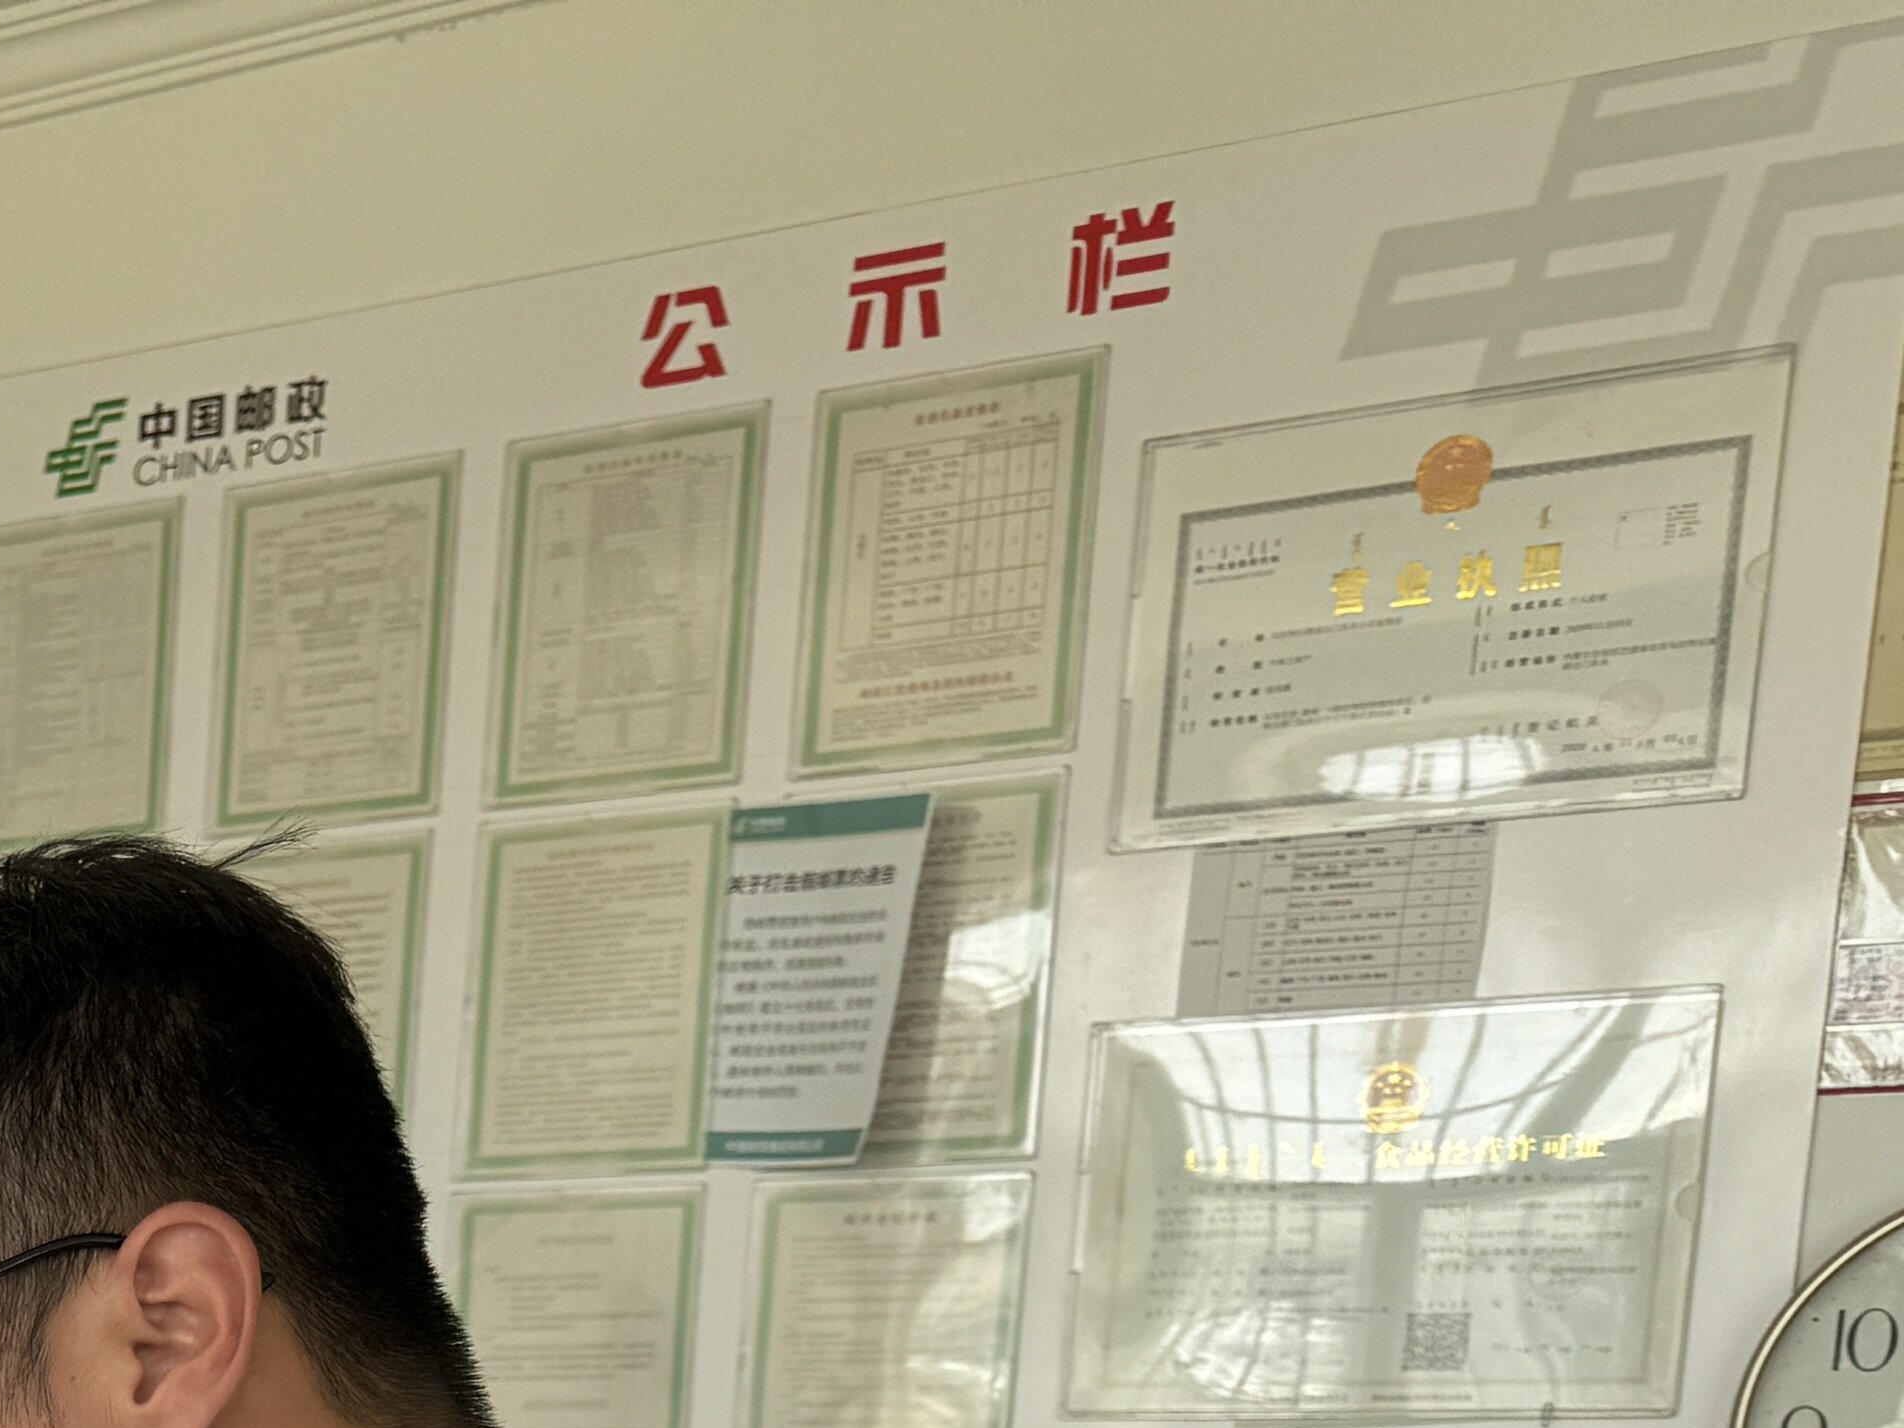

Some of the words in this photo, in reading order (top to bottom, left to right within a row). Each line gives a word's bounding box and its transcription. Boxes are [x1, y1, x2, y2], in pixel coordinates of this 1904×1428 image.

[641, 200, 1176, 389] 公示栏
[138, 375, 329, 449] 中国邮政
[133, 444, 236, 487] CHINA
[245, 427, 326, 469] POST
[1832, 1308, 1898, 1372] 10
